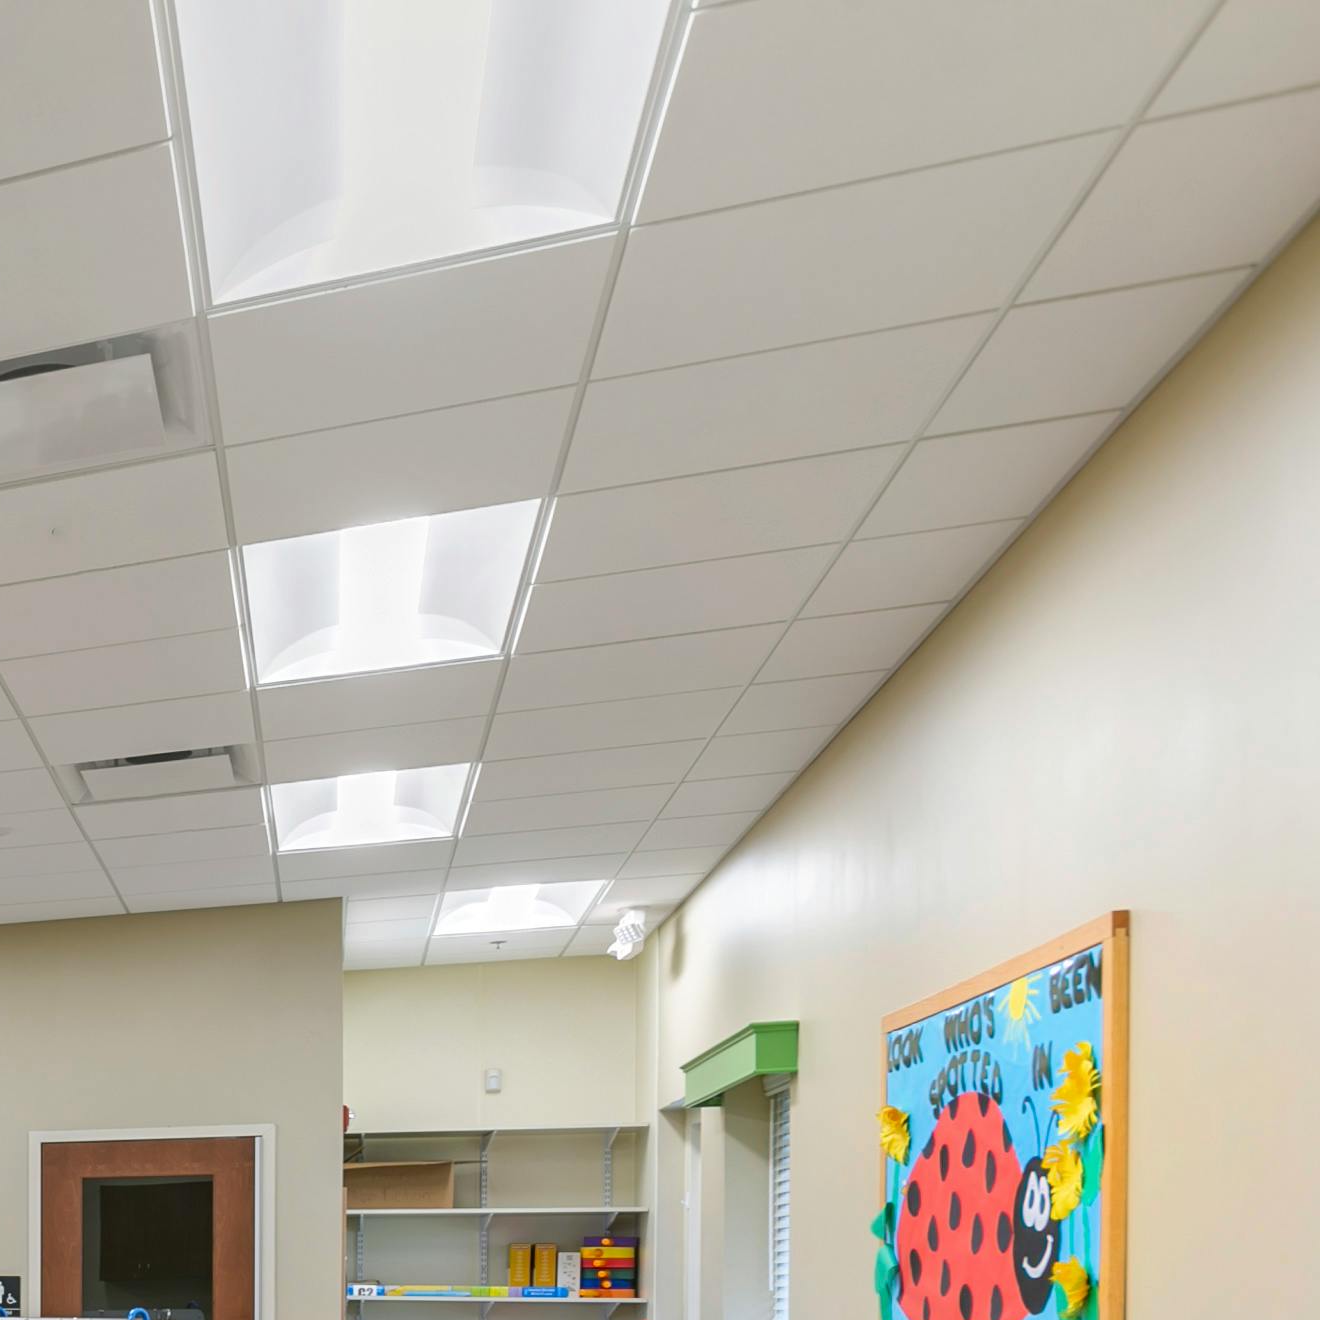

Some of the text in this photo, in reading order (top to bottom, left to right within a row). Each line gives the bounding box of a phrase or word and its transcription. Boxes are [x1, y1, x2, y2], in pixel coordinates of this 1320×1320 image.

[944, 995, 995, 1054] WHO'S
[1050, 955, 1102, 1014] BEEN
[929, 1040, 1053, 1120] SPOTTED IN
